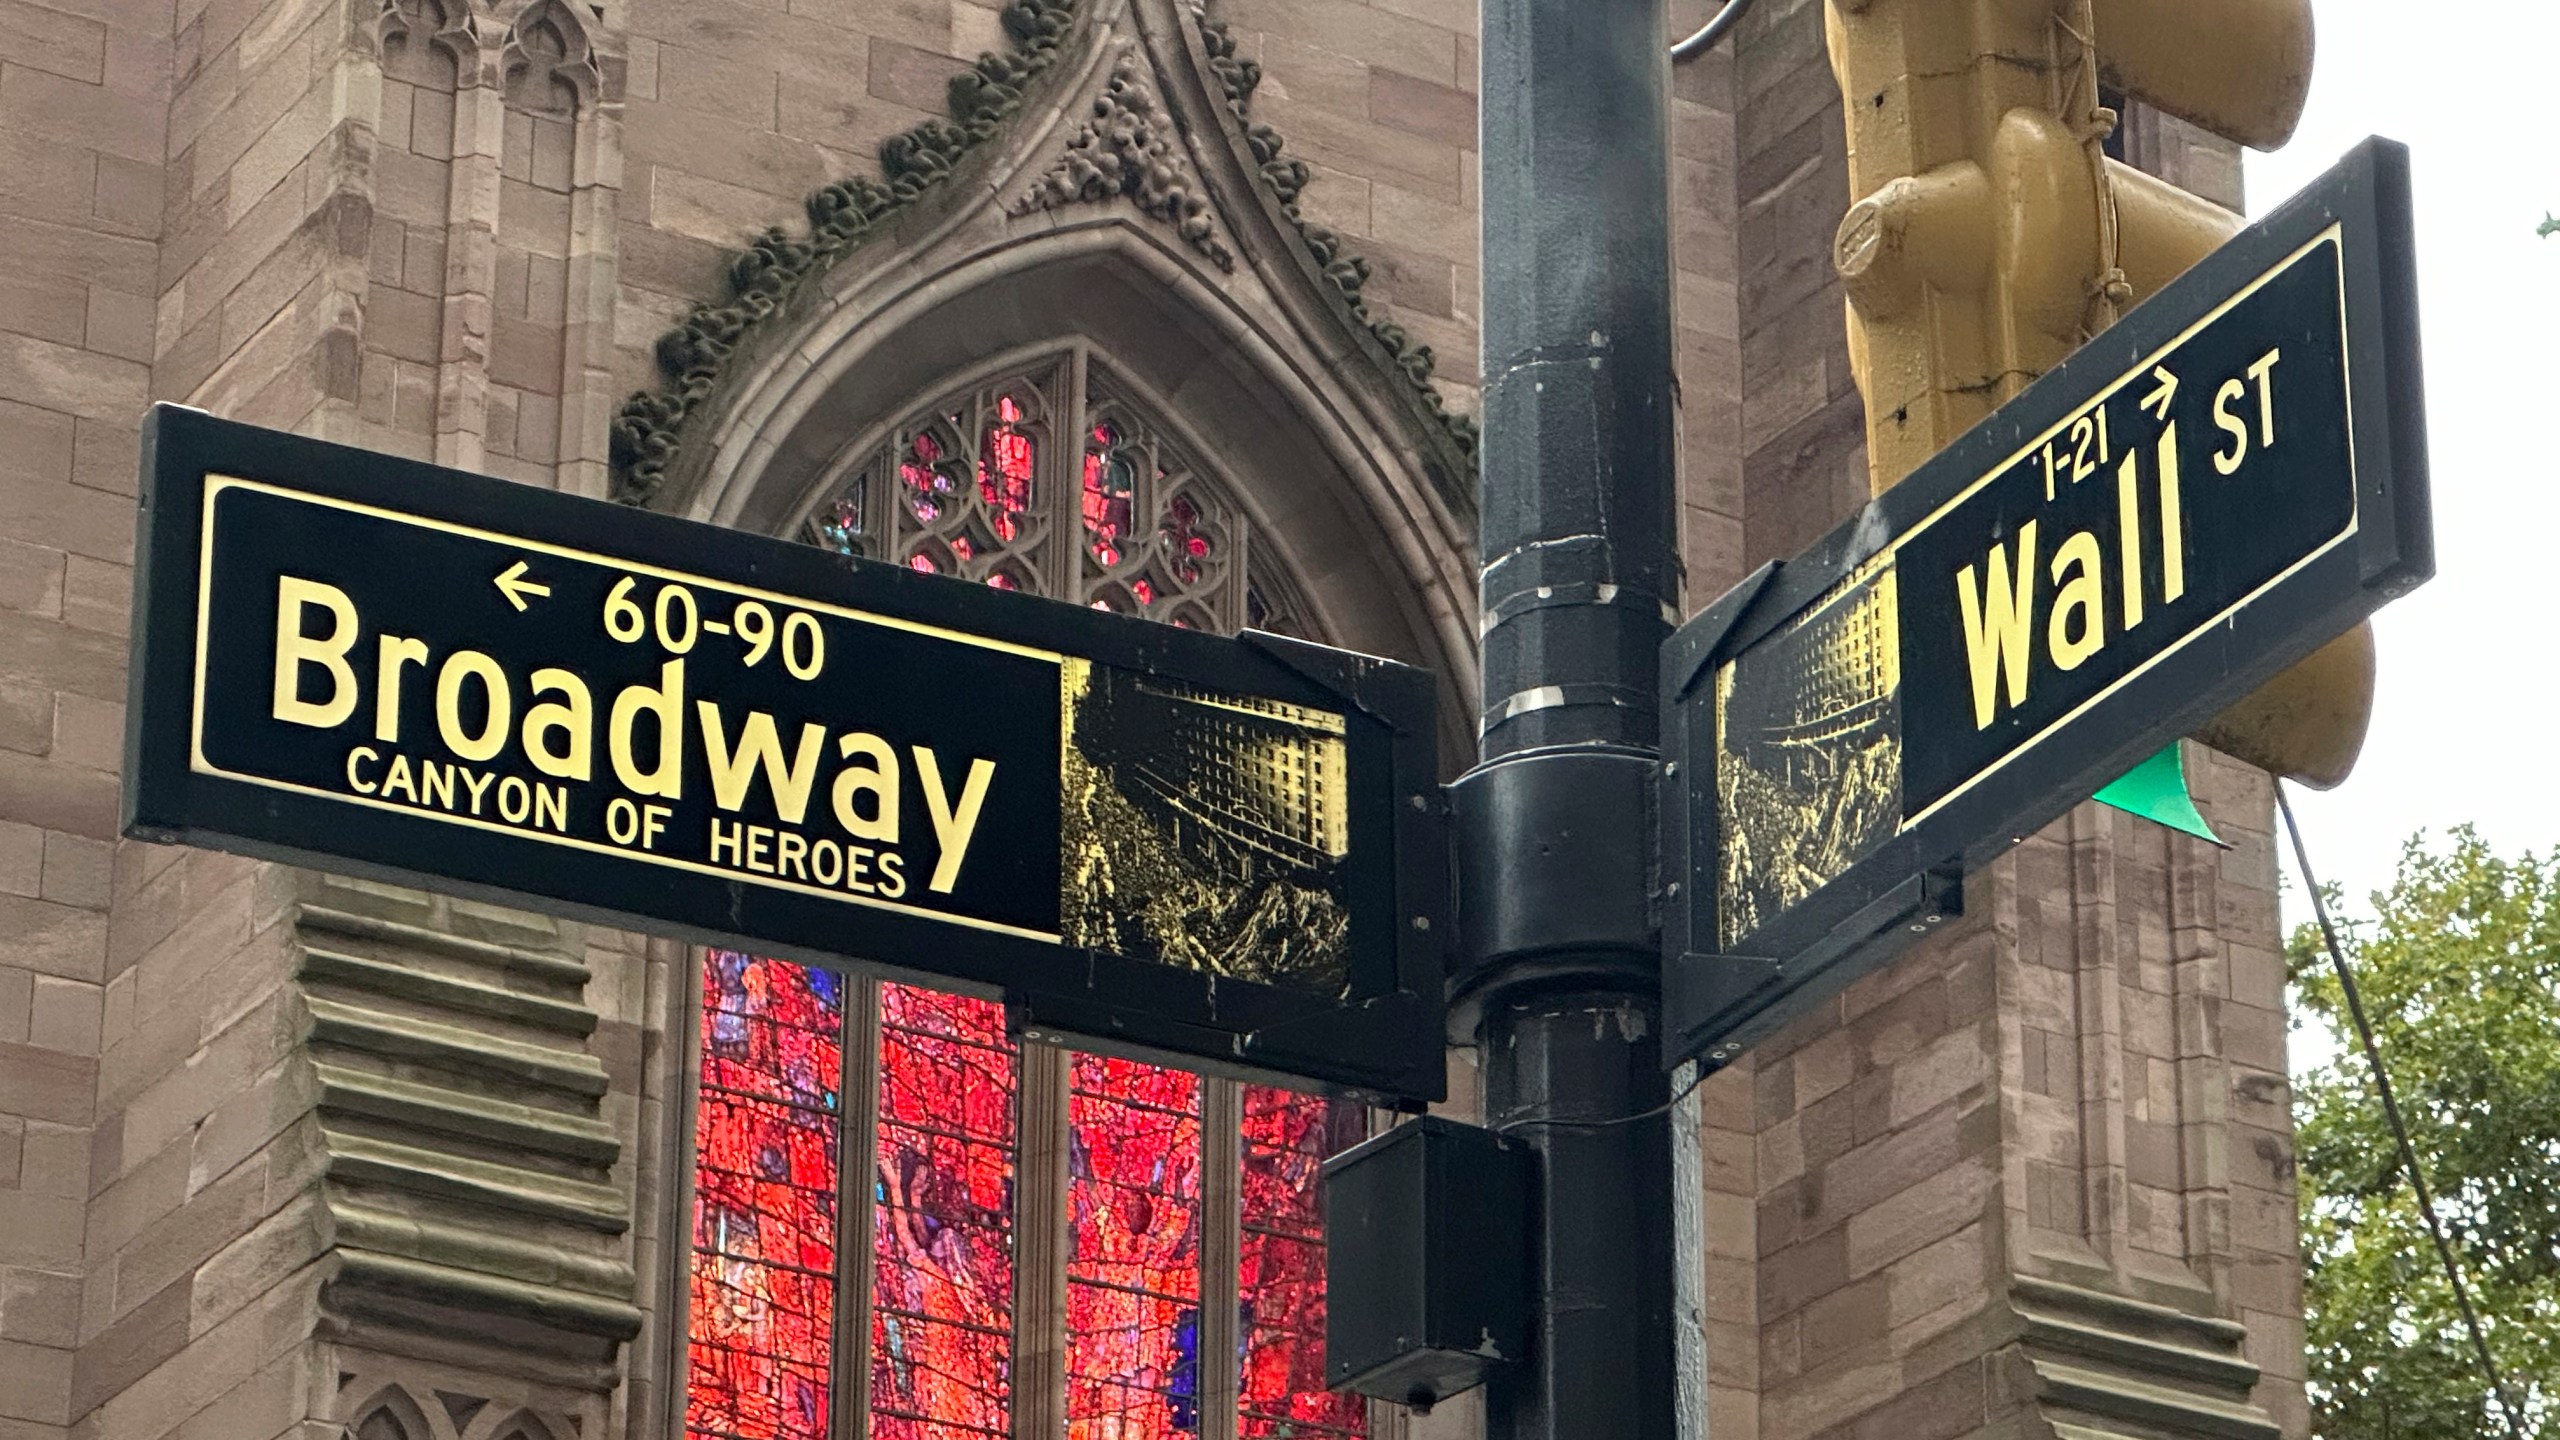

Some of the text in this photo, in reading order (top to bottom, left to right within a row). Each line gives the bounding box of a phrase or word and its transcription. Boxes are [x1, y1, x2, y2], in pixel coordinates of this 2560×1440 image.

[2042, 402, 2109, 502] 1-21
[1956, 347, 2280, 732] Wall ST
[603, 575, 825, 681] 60-90
[272, 575, 996, 894] Broadway
[347, 746, 906, 898] CANYON OF HEROES
